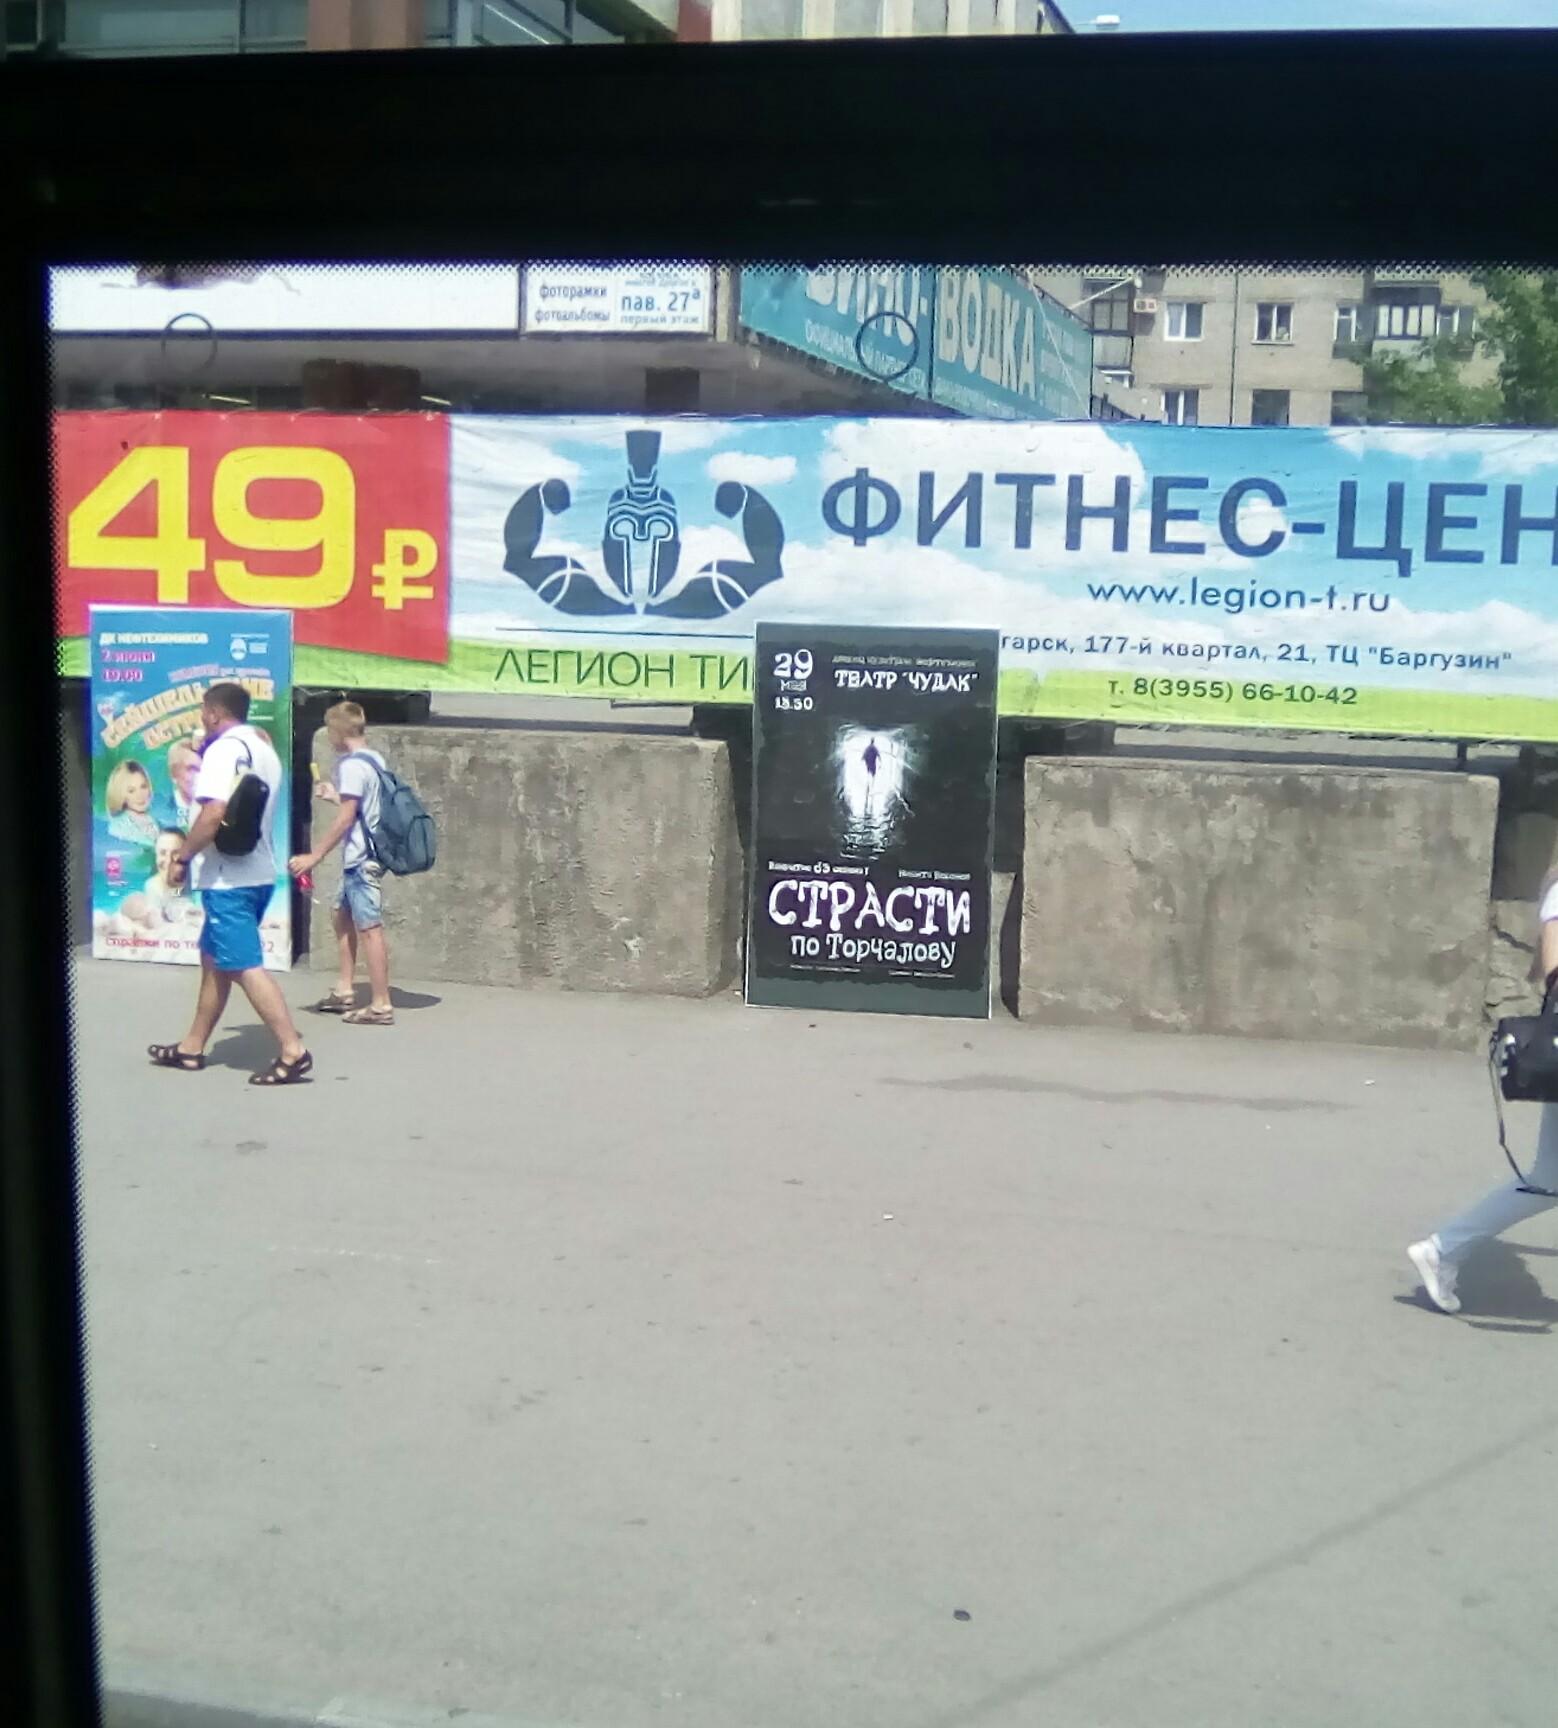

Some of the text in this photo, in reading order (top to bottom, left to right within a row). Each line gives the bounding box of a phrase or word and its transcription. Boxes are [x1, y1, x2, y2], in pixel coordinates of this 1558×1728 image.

[539, 284, 607, 300] фоторамки
[621, 295, 660, 311] пав.
[534, 307, 610, 323] фотоальбомы
[620, 315, 699, 325] первый этаж
[938, 266, 1036, 401] ВОДКА
[67, 446, 356, 609] 49
[822, 467, 1558, 577] ФИТНЕС-ЦЕН
[1086, 577, 1391, 613] www.legion-t.ru
[494, 648, 754, 691] ЛЕГИОН ТИ
[773, 649, 813, 679] 29
[1001, 635, 1513, 671] гарск, 177-й квартал, 21, ТЦ "Баргузин"
[834, 669, 979, 693] ТЕАТР "ЧУДАК"
[1133, 678, 1234, 703] 8(3955)
[1242, 682, 1358, 705] 66-10-42
[768, 879, 970, 936] СТРАСТИ
[164, 941, 180, 949] по
[791, 933, 956, 969] по Торчалову
